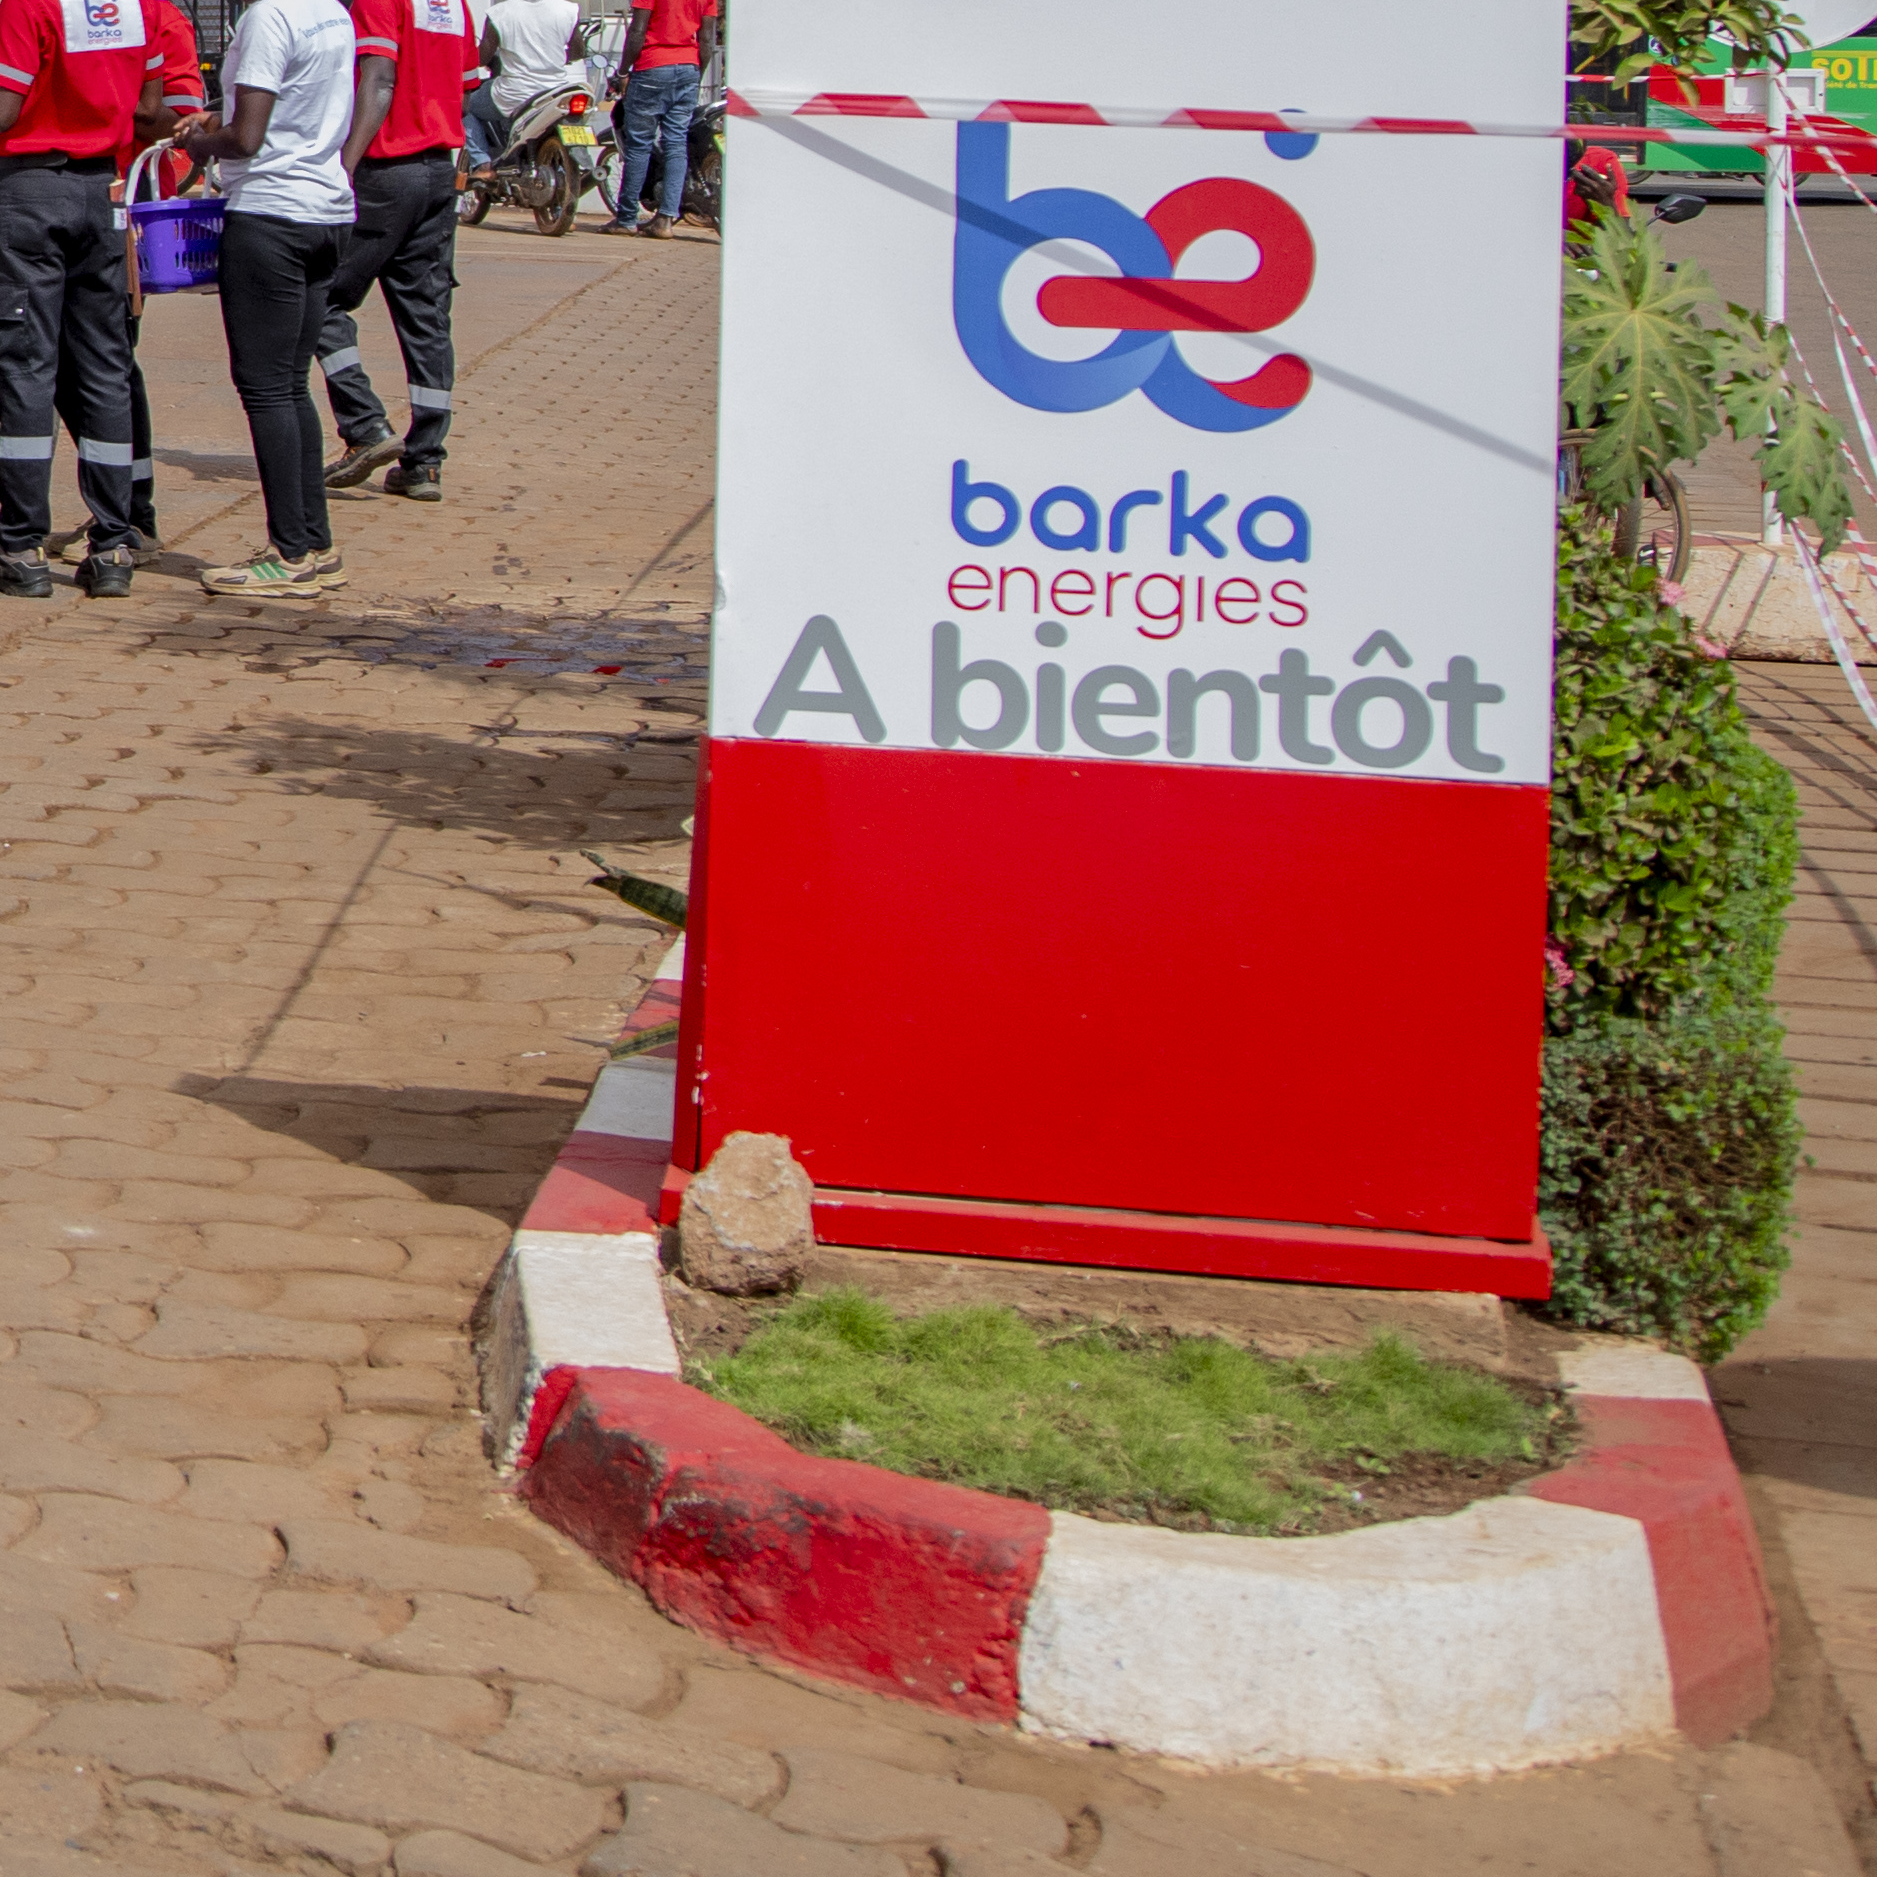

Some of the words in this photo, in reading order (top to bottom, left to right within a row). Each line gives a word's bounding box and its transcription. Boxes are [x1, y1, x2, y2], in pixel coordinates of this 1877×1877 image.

[87, 28, 122, 38] barka
[951, 459, 1312, 564] barka
[947, 563, 1309, 640] energies
[753, 614, 888, 744] A
[931, 619, 1506, 774] bientôt
